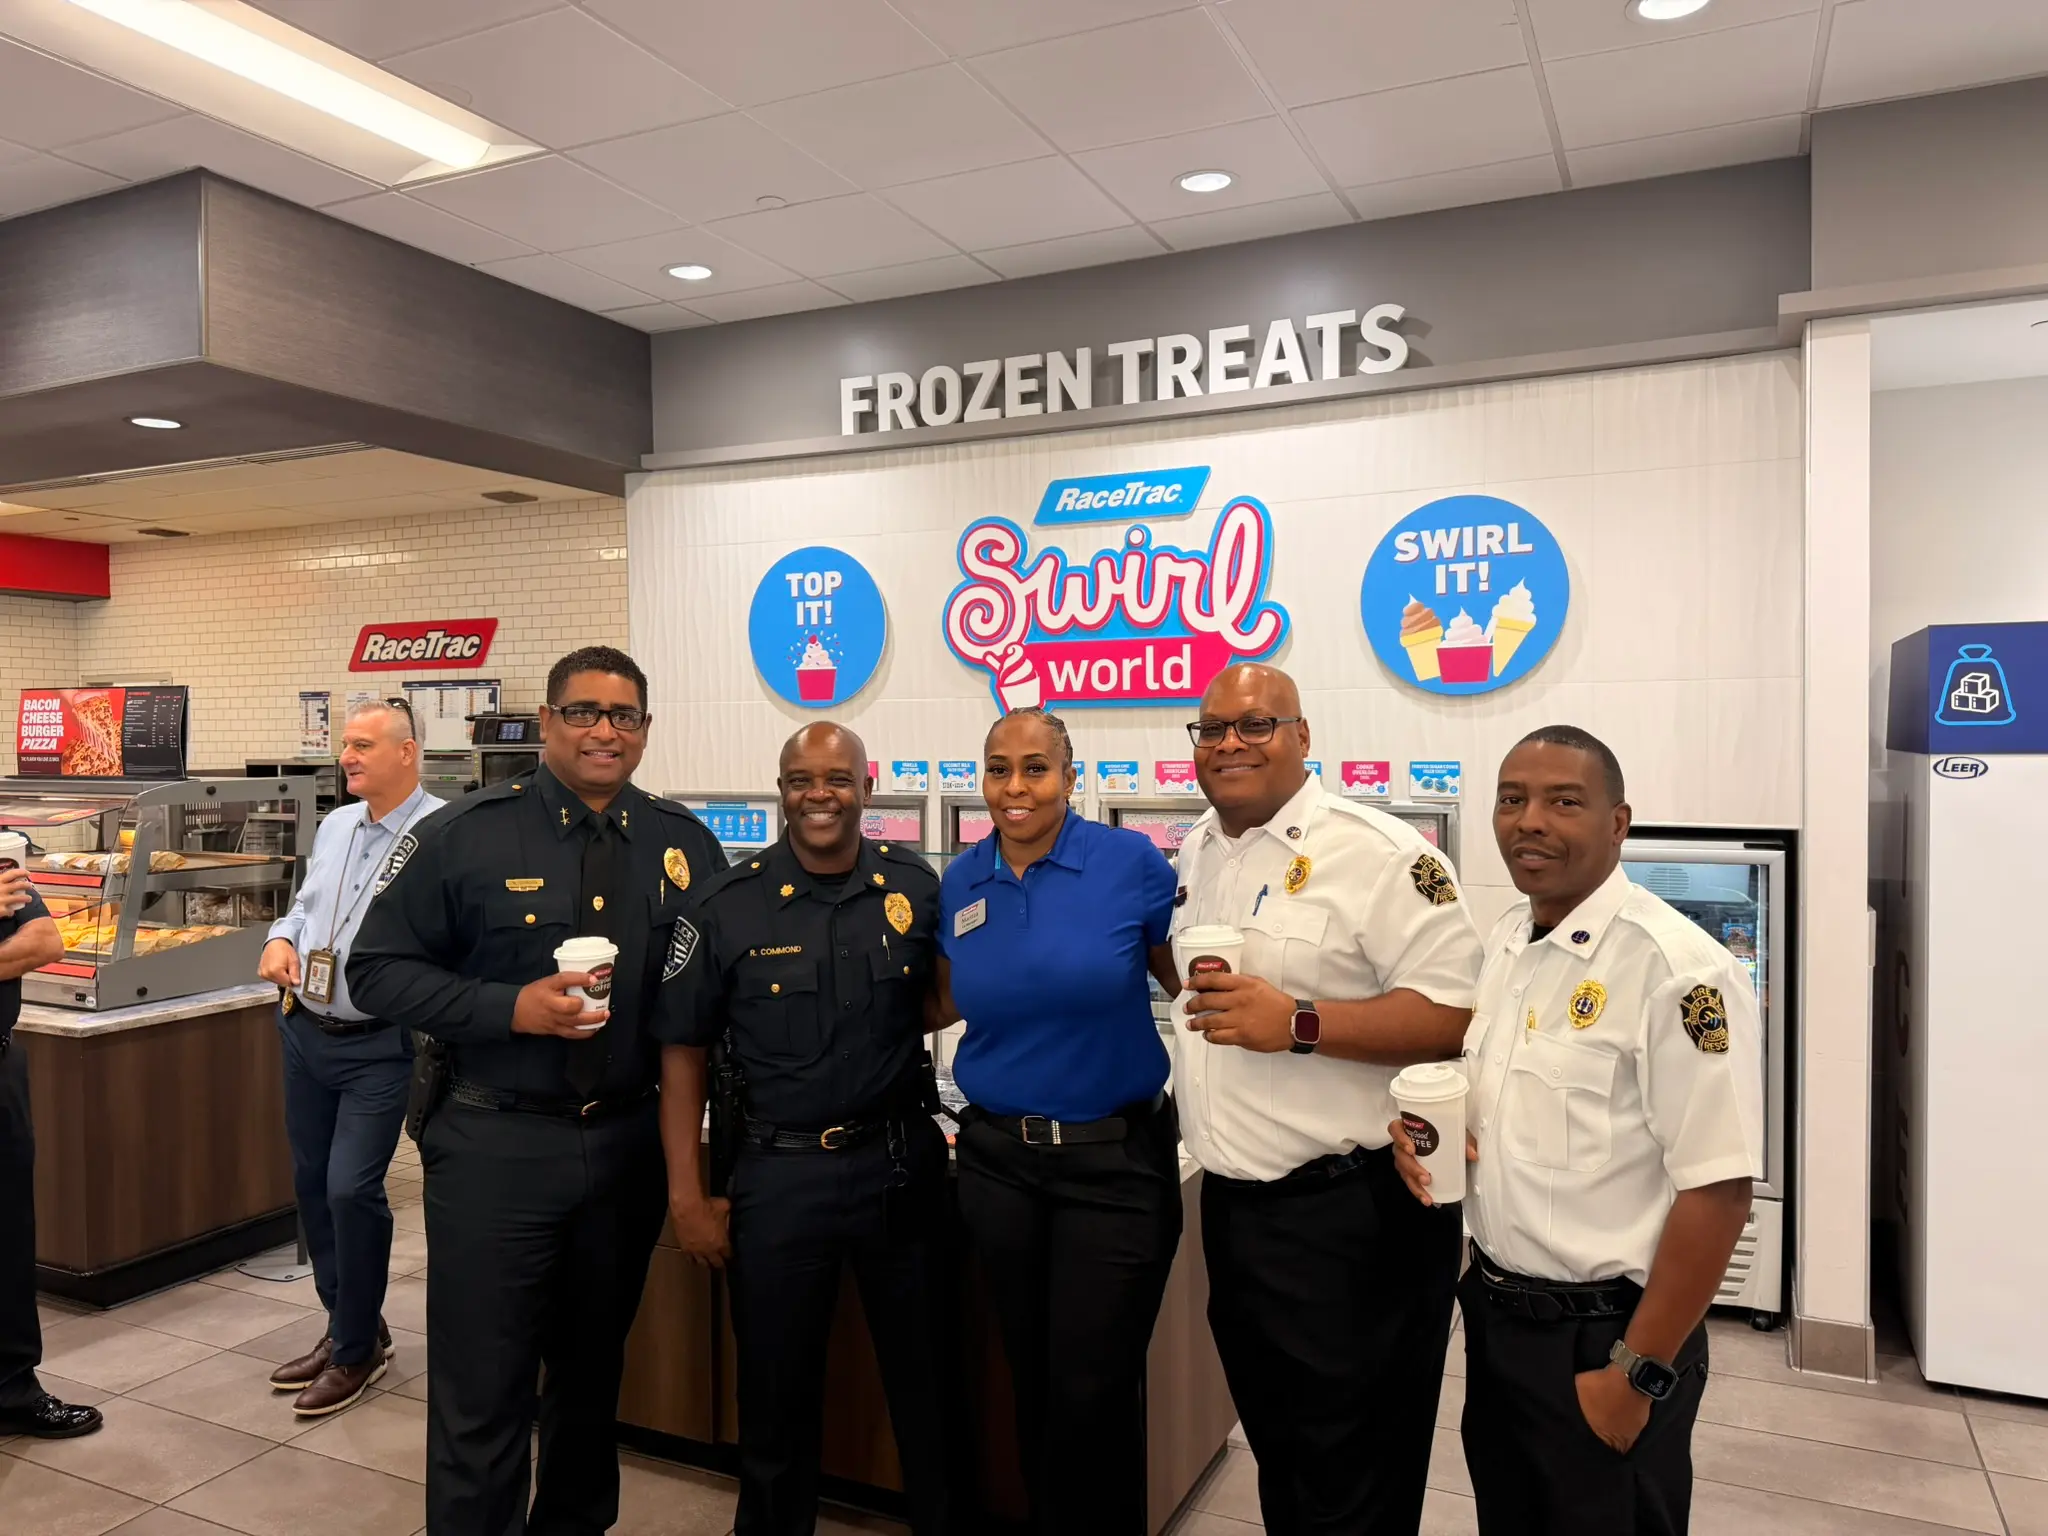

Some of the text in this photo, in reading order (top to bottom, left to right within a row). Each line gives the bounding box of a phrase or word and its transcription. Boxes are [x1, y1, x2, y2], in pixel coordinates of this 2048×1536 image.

[840, 303, 1409, 436] FROZEN TREATS
[1055, 481, 1183, 512] RaceTrac
[1393, 522, 1534, 564] SWIRL
[785, 570, 842, 597] TOP
[947, 502, 1282, 664] Swirl
[1435, 561, 1490, 596] IT!
[796, 600, 832, 626] IT!
[361, 630, 481, 662] RaceTrac
[1047, 643, 1192, 693] world
[22, 711, 63, 724] CHEESE
[24, 698, 61, 711] BACON
[21, 725, 64, 737] BURGER
[21, 738, 58, 750] PIZZA
[1943, 758, 1979, 777] LEER
[1691, 987, 1711, 1000] FIRE
[1691, 999, 1706, 1025] RIVIERA
